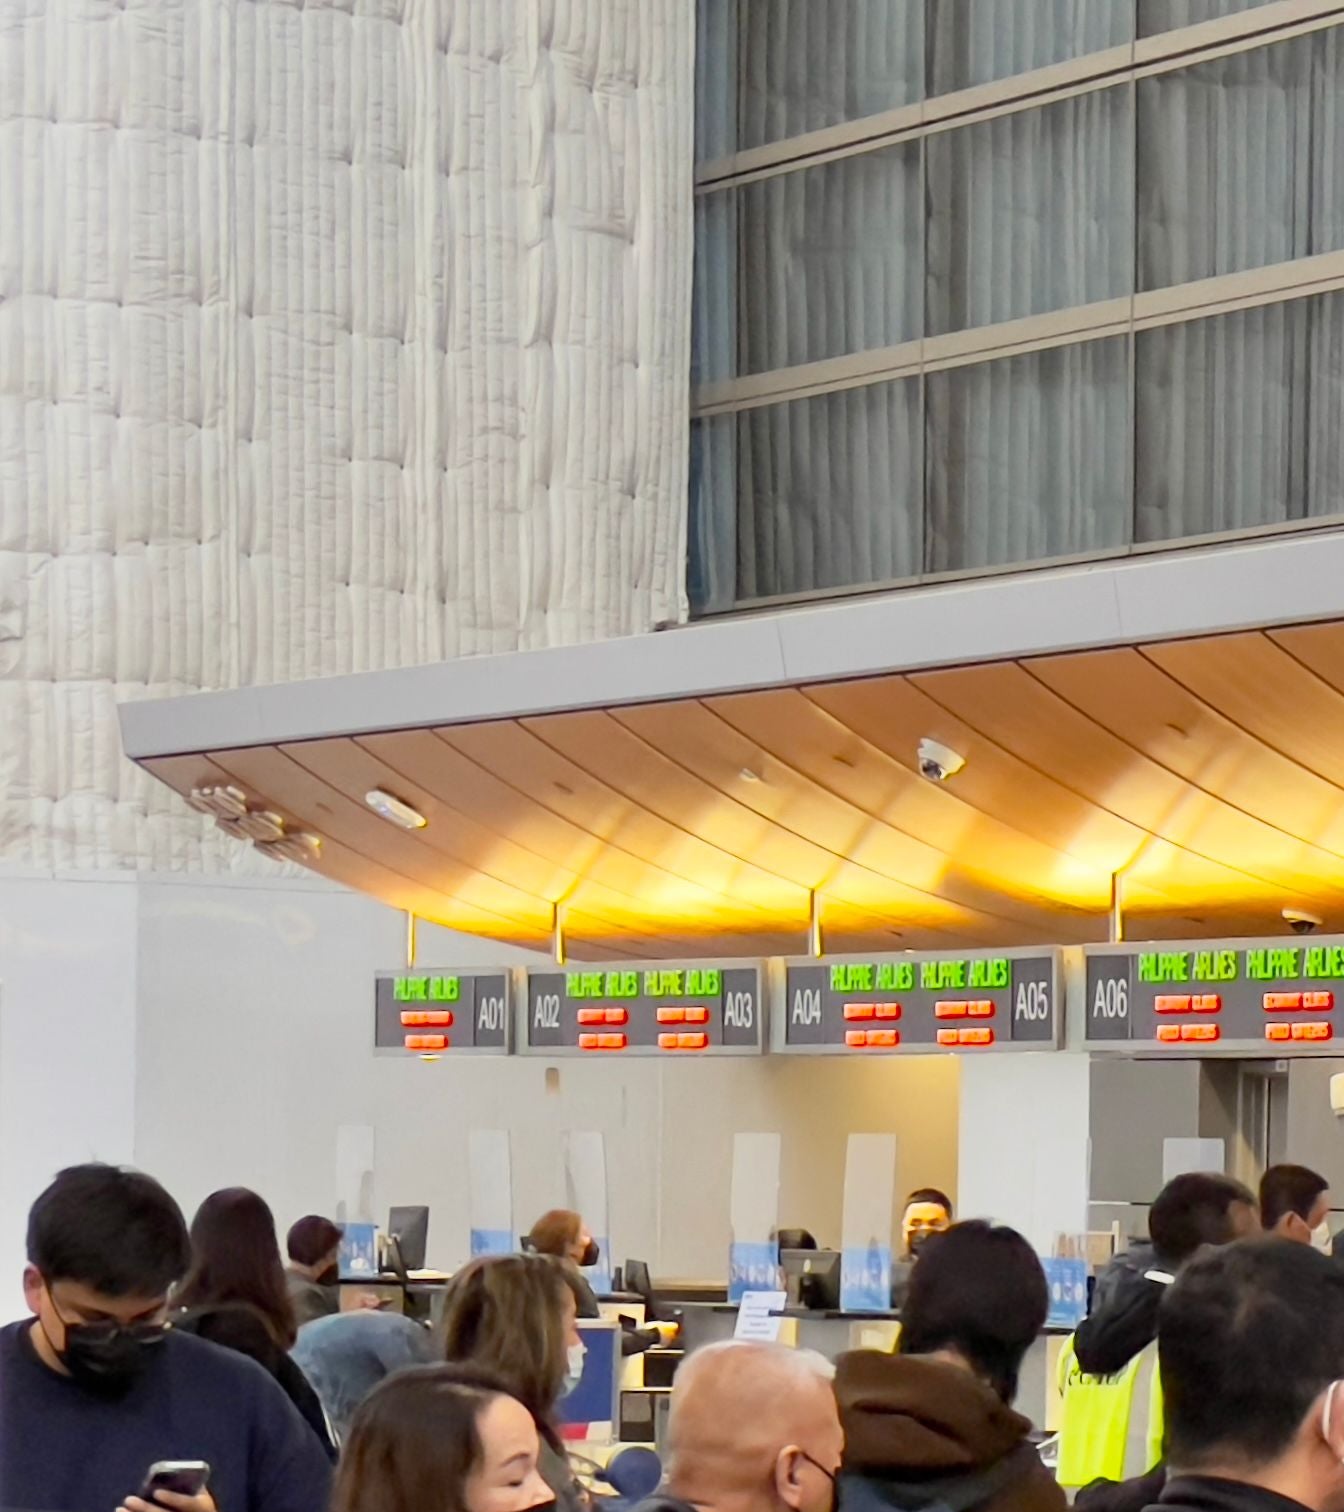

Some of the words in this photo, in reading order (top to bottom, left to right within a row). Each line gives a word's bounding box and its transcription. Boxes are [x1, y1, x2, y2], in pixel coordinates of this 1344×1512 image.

[479, 997, 505, 1030] A01
[534, 995, 560, 1028] A02
[724, 992, 753, 1028] A03
[792, 989, 822, 1025] A04
[1015, 982, 1048, 1020] A05
[1093, 979, 1128, 1017] A06
